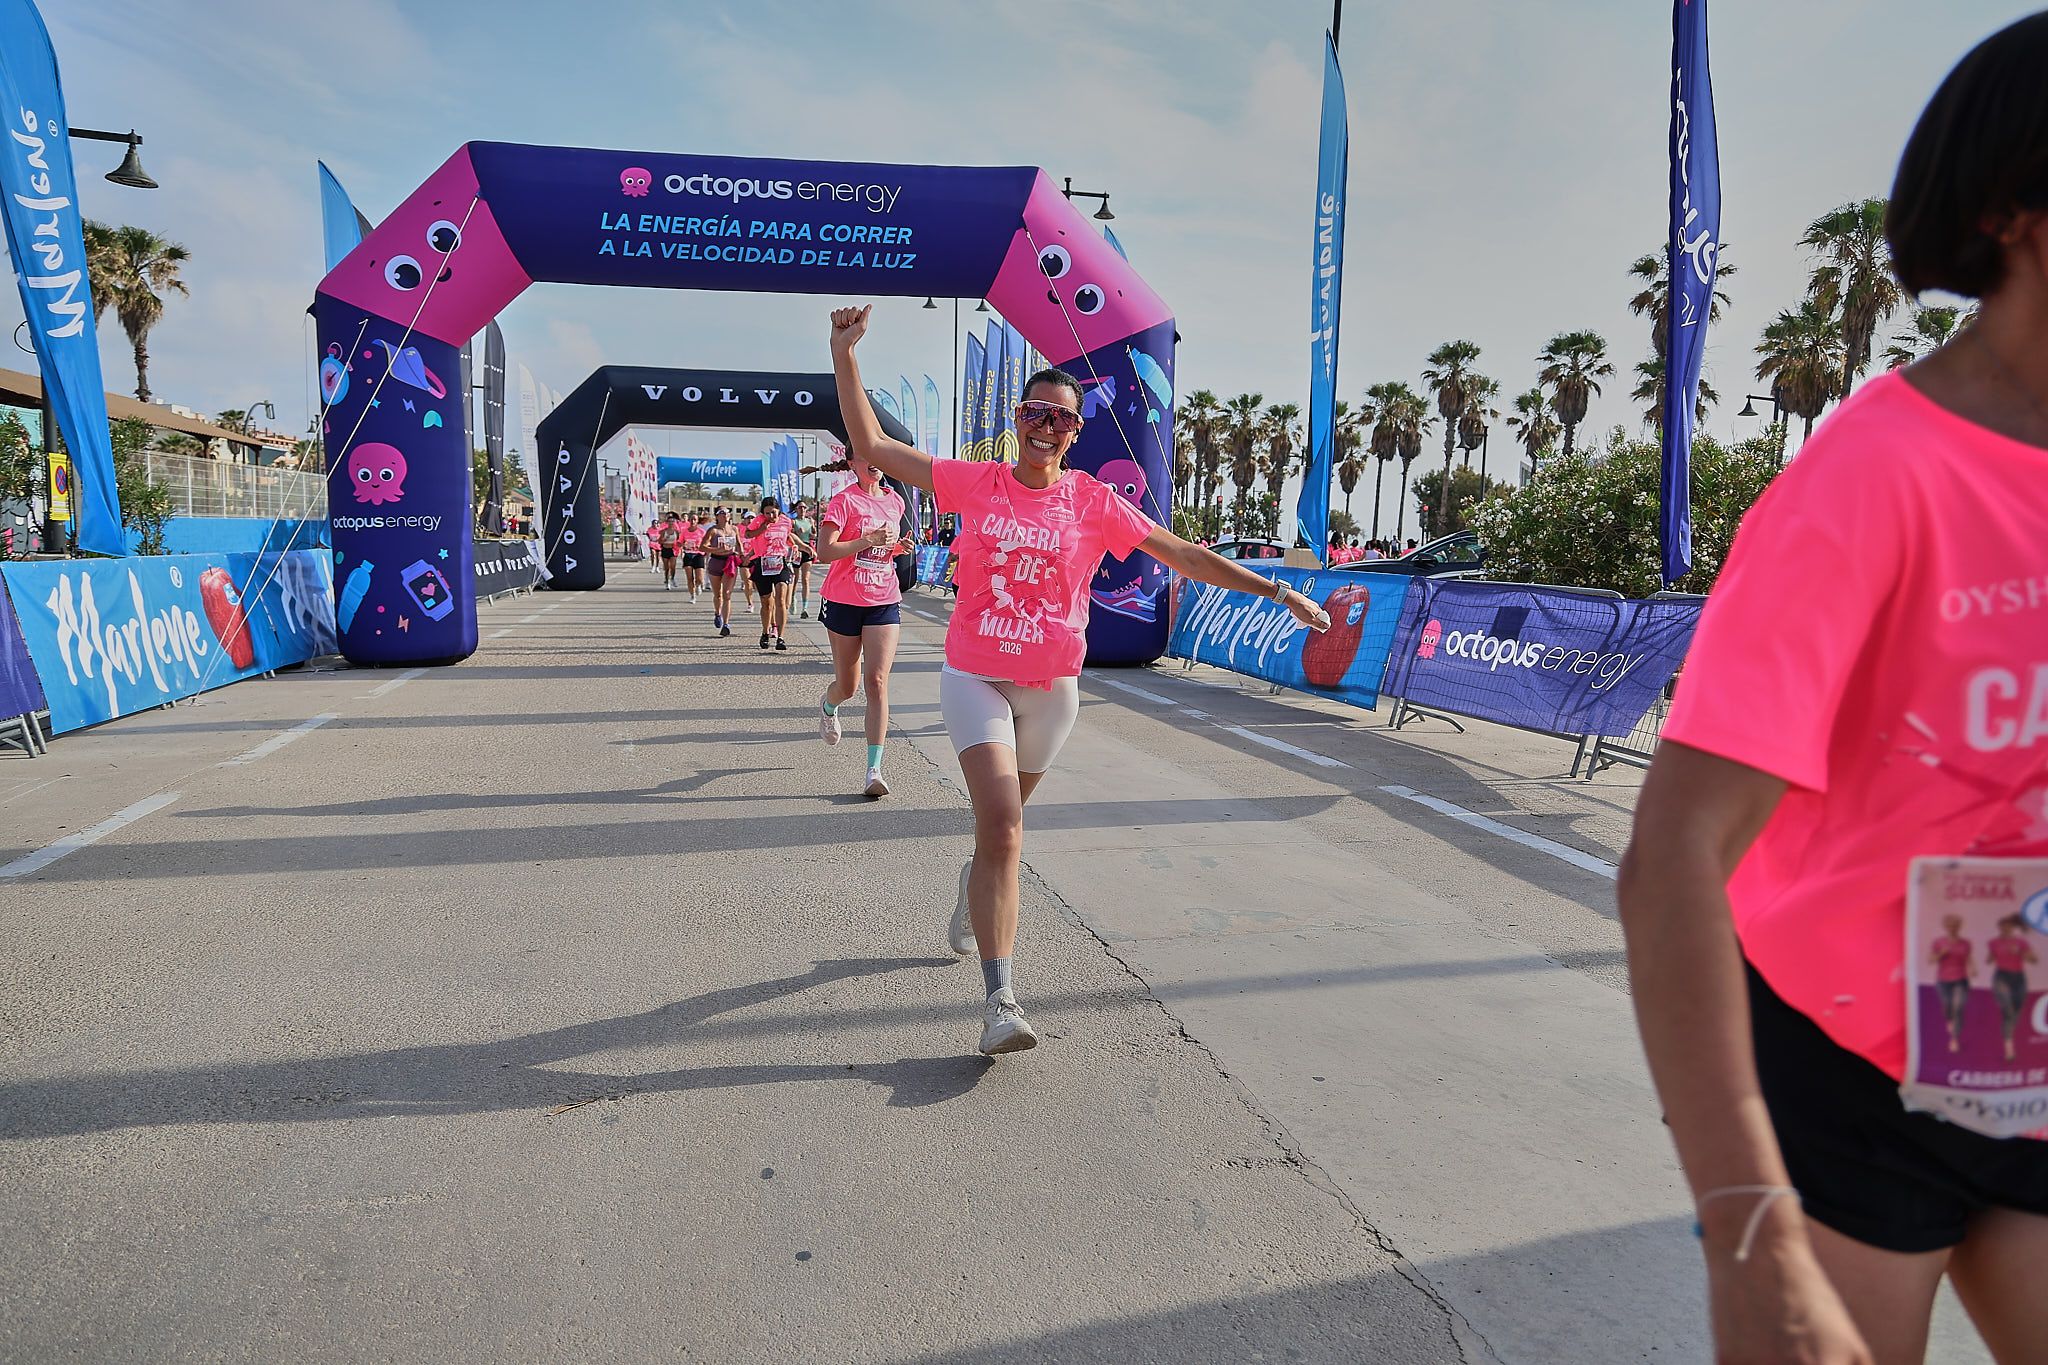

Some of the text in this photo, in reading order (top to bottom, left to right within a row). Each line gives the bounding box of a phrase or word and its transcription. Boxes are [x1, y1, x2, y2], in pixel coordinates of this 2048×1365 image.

[664, 173, 901, 213] octopus energy
[600, 212, 913, 245] LA ENERGÍA PARA CORRER
[598, 239, 917, 269] A LA VELOCIDAD DE LA LUZ
[640, 384, 814, 406] VOLVO
[691, 460, 737, 480] Marlene
[333, 516, 442, 532] octopus energy
[557, 449, 578, 573] VOLVO
[474, 559, 503, 576] OLVO
[1015, 554, 1044, 585] DE
[979, 614, 1044, 644] MUJER
[1183, 572, 1297, 668] Marlene
[46, 568, 208, 718] Marlene
[999, 640, 1022, 655] 2026
[1446, 629, 1644, 690] octopus energy
